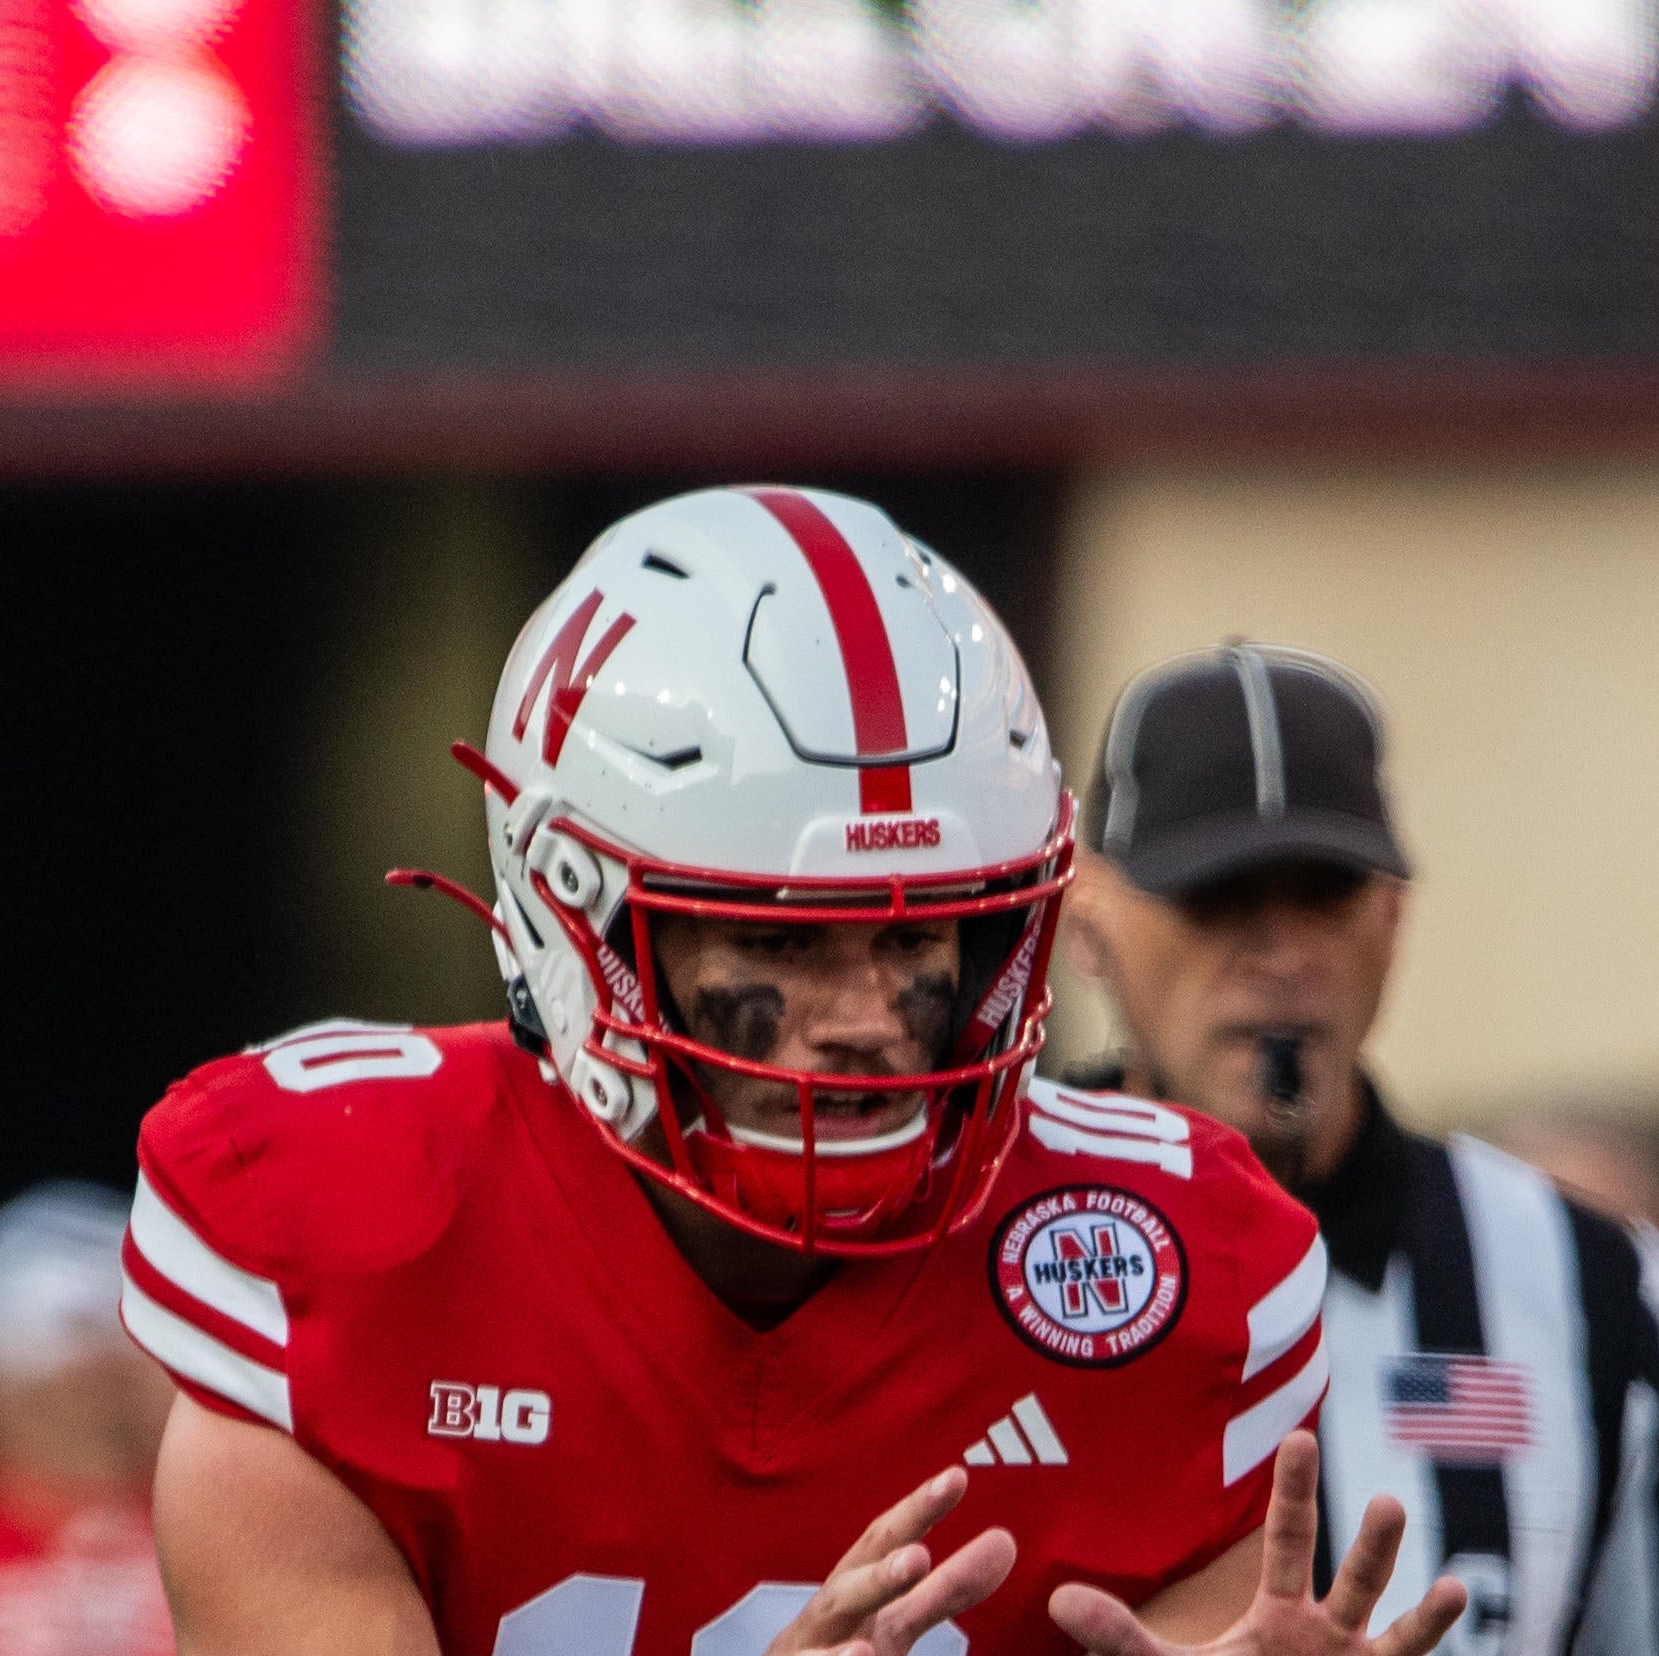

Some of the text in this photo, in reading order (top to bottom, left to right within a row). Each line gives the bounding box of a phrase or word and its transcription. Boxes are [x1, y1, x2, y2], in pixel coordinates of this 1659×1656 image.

[512, 587, 637, 770] N
[846, 818, 941, 851] HUSKERS
[1028, 1077, 1193, 1180] 10
[1002, 1190, 1171, 1264] NEBRASKA FOOTBALL
[1033, 1254, 1145, 1285] HUSKERS
[1007, 1274, 1177, 1358] A WINNING TRADITION
